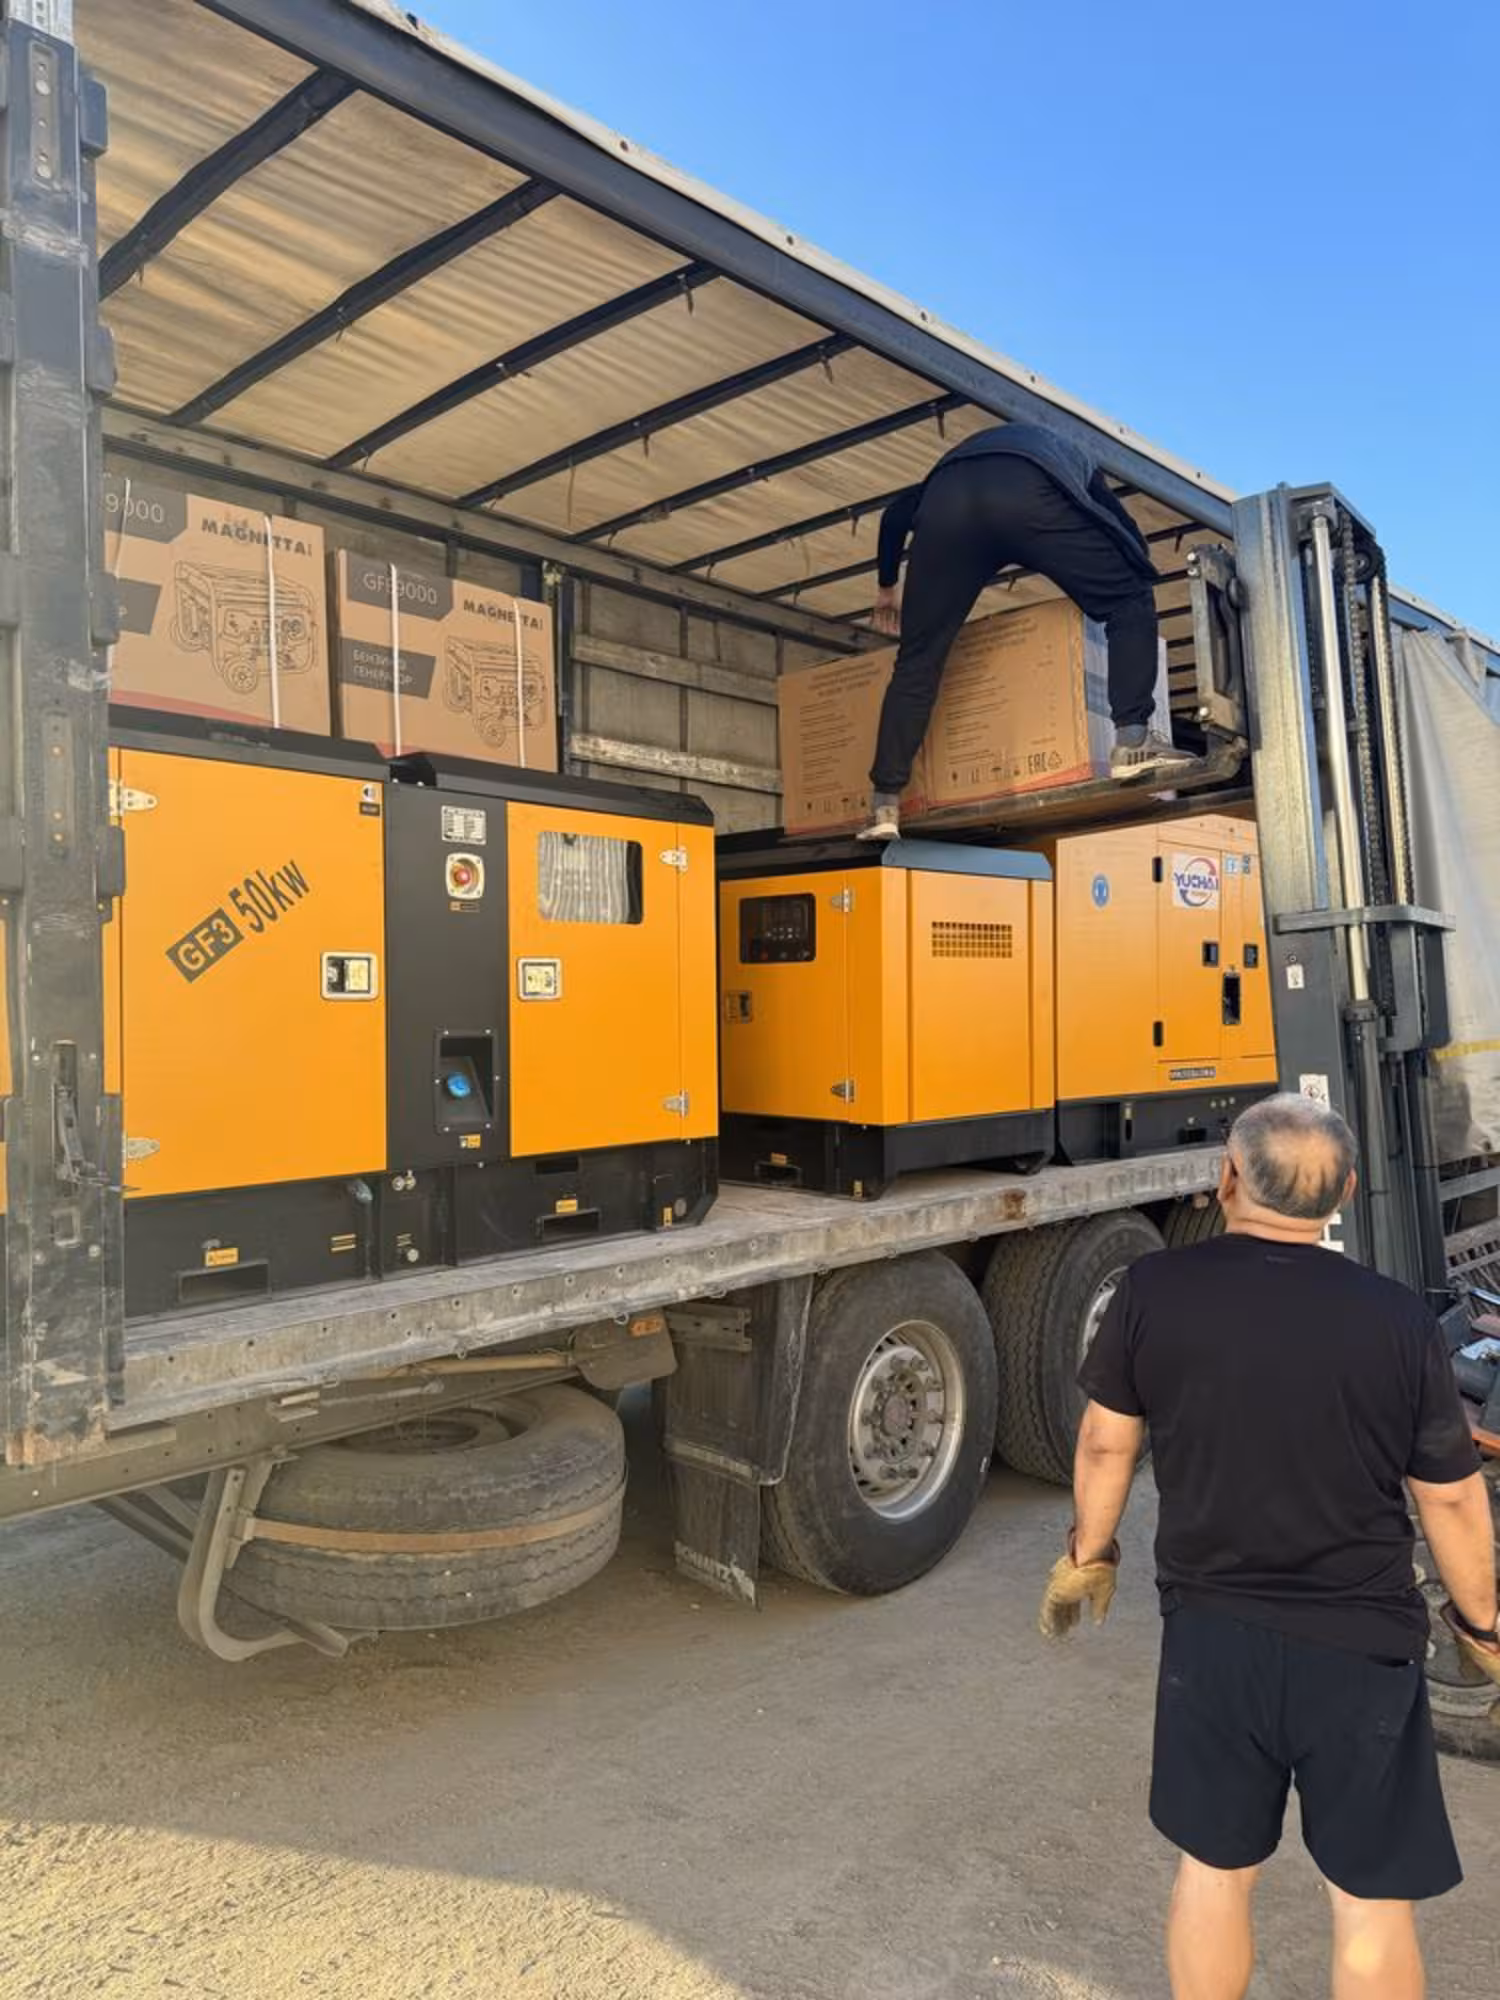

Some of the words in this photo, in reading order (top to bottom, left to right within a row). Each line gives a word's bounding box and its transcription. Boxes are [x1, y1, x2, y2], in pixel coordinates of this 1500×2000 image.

[1173, 872, 1219, 891] YUCHAI
[175, 915, 237, 974] GF3
[228, 859, 310, 933] 50kW
